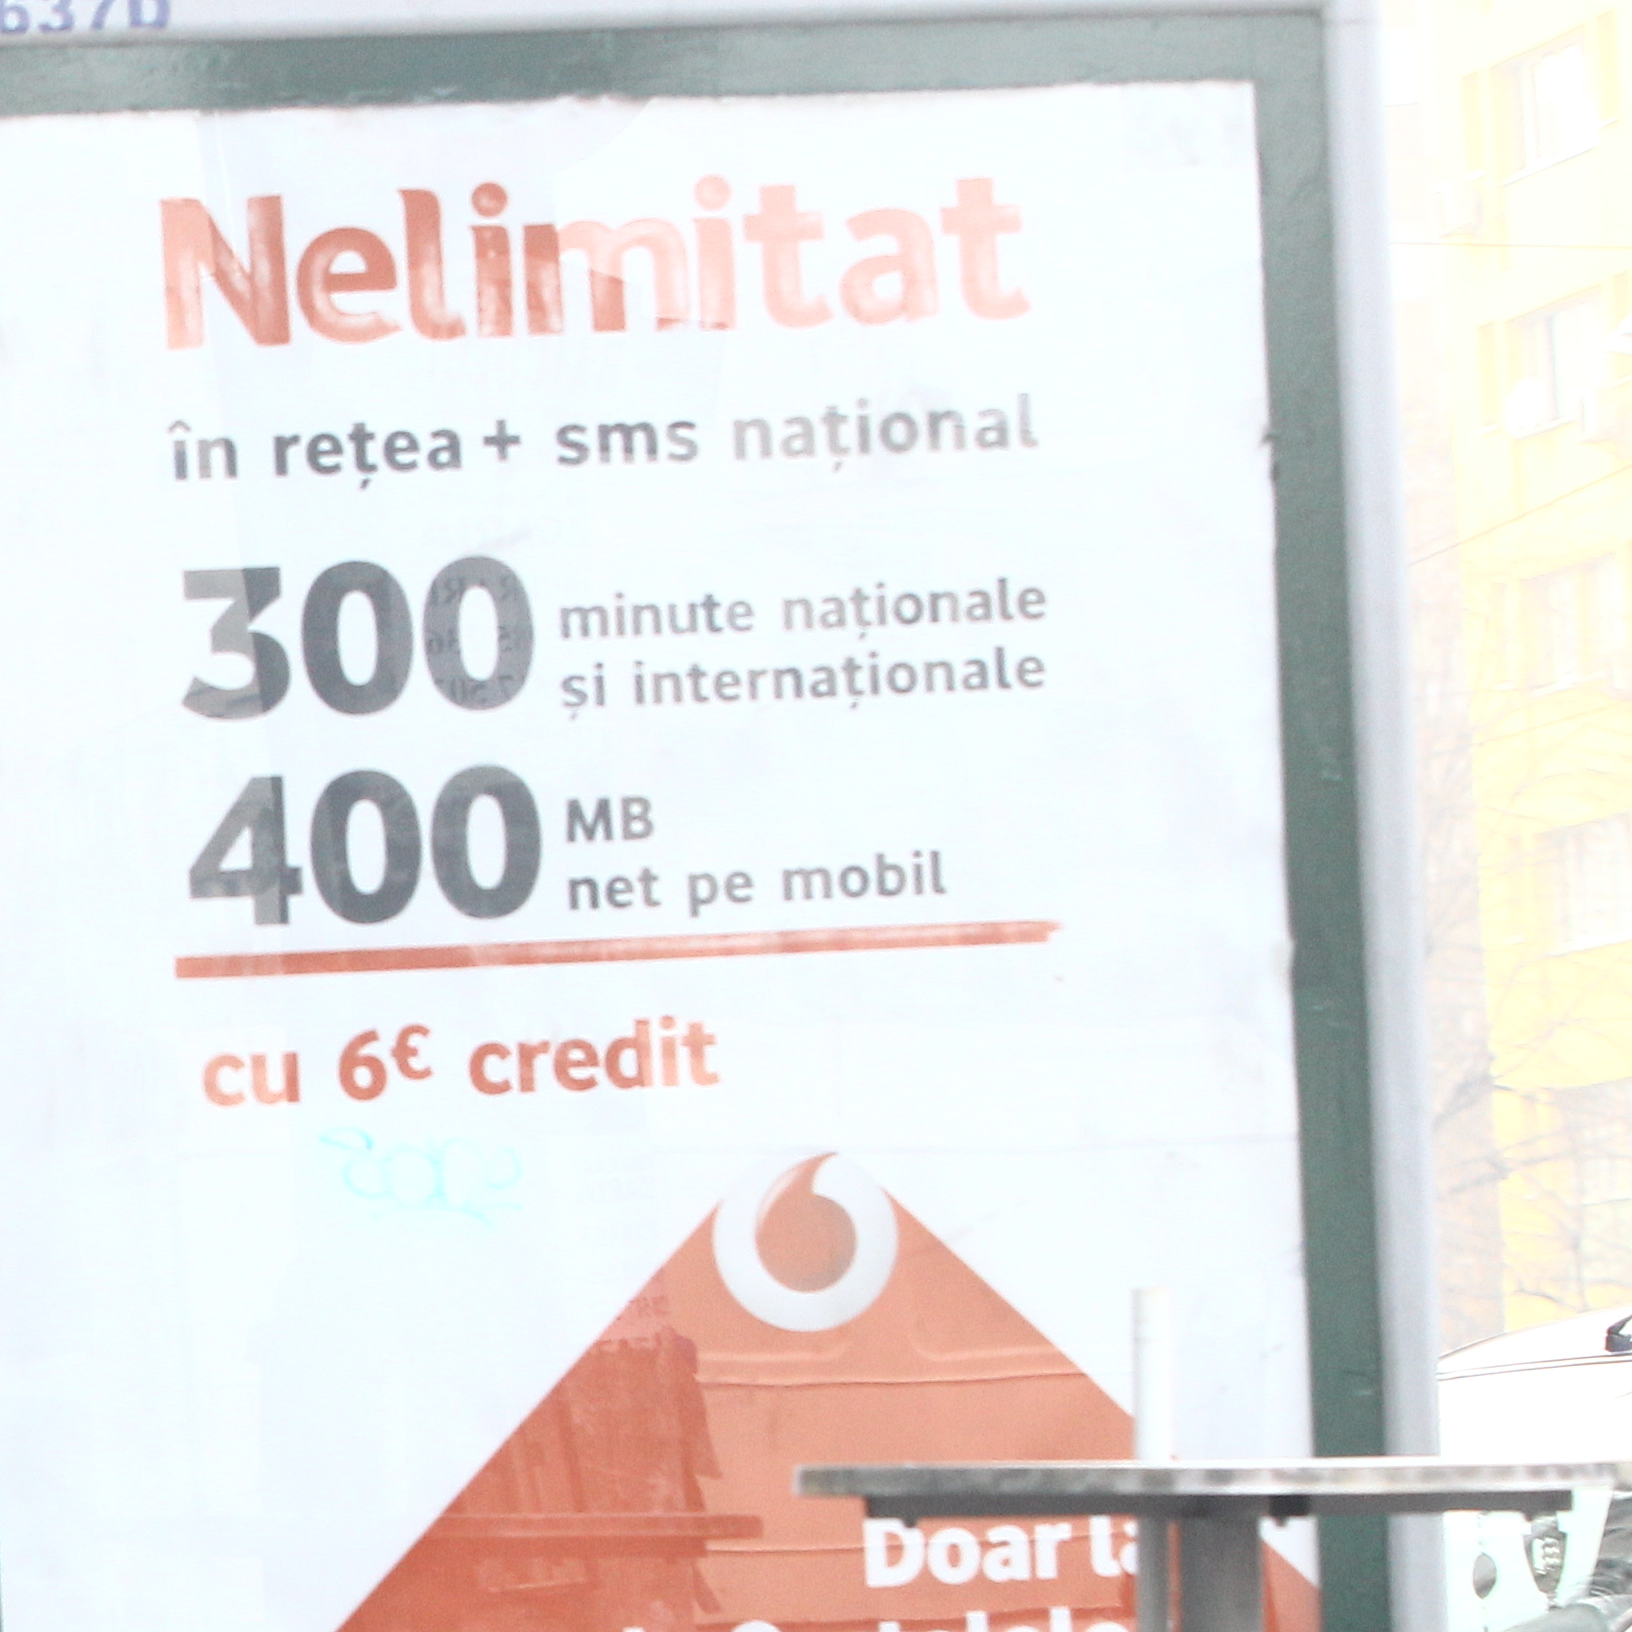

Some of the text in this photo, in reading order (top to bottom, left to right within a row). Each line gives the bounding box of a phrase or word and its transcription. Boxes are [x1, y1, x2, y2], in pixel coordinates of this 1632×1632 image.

[160, 174, 1033, 350] Nelimitat
[170, 422, 238, 481] în
[482, 420, 521, 463] +
[554, 418, 698, 467] sms
[732, 393, 1039, 472] național
[181, 556, 535, 721] 300
[560, 577, 1048, 639] minute naționale
[634, 645, 1047, 709] internaționale
[188, 765, 542, 927] 400
[565, 797, 654, 843] MB
[568, 852, 946, 916] net pe mobil
[202, 1014, 720, 1106] cu 6€ credit
[864, 1518, 1073, 1588] Doar
